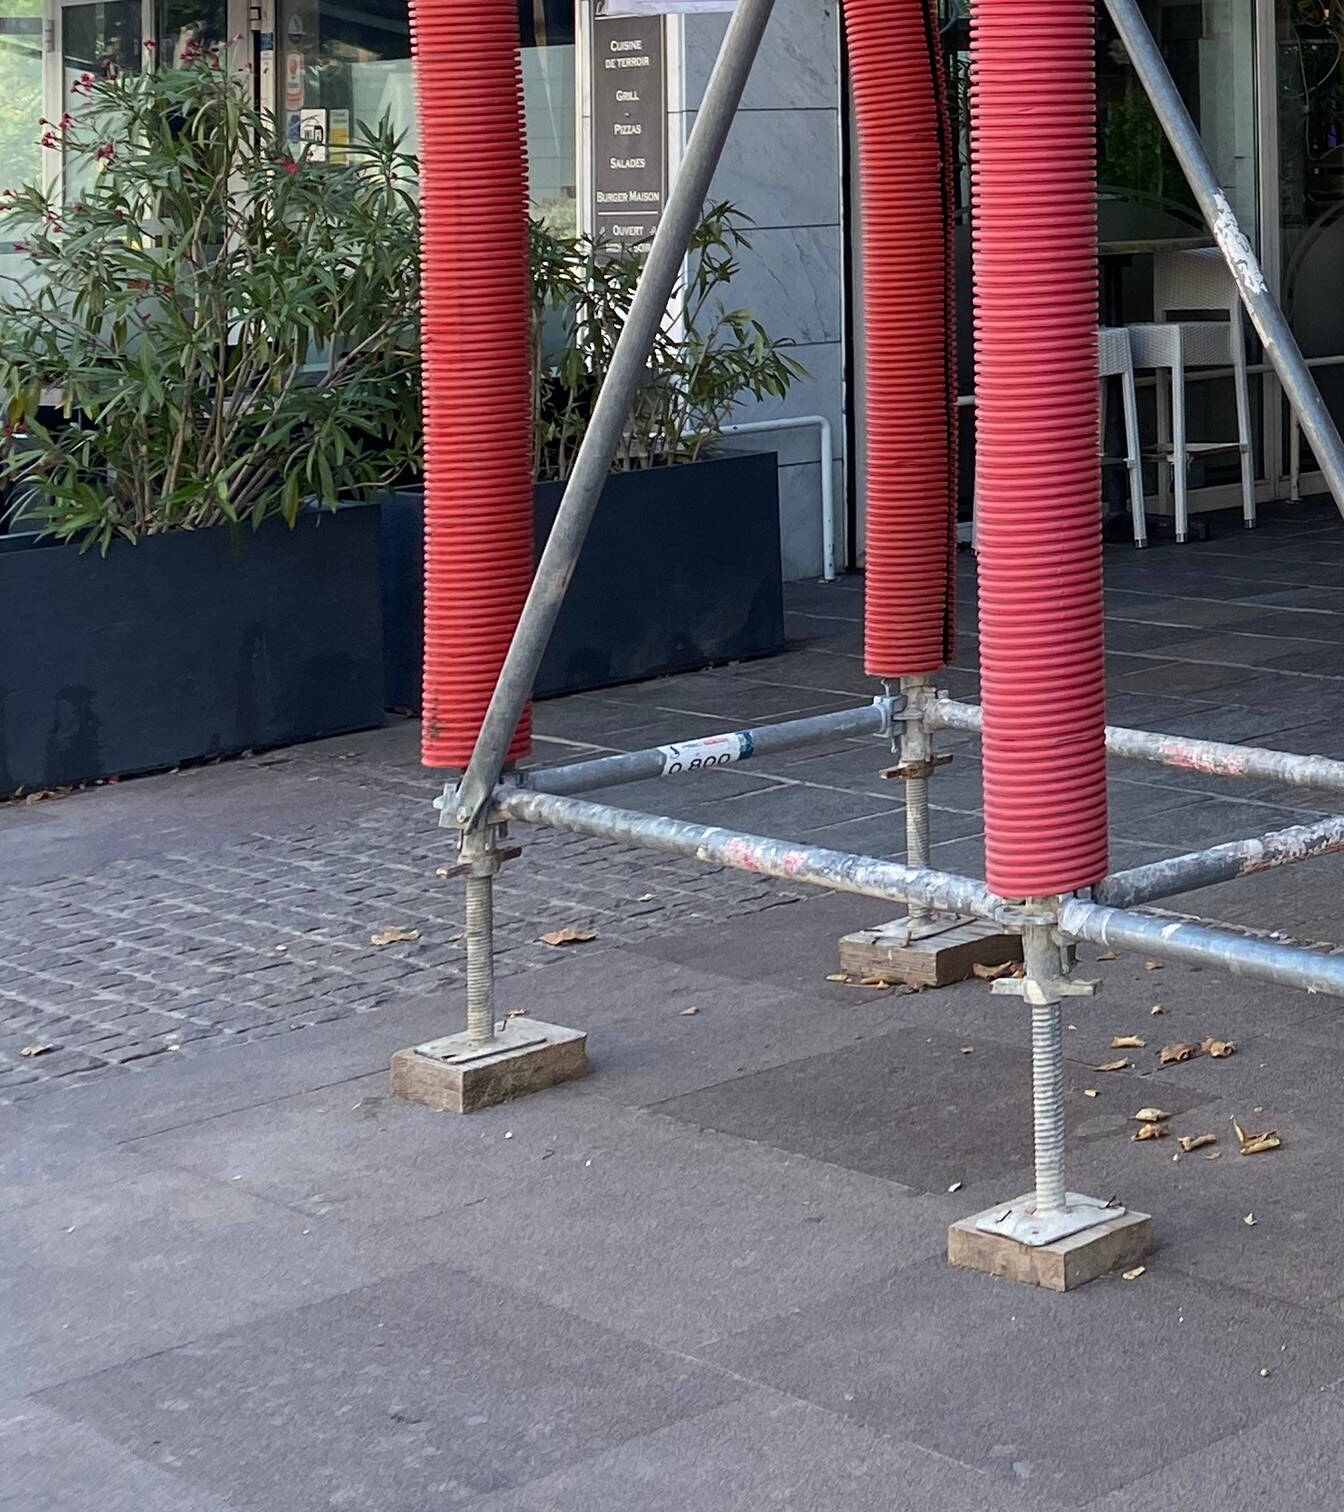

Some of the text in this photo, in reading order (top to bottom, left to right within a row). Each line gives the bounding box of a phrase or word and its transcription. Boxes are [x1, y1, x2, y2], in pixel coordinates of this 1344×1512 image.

[614, 124, 642, 135] PIZZAS
[610, 157, 646, 169] SALADES
[597, 190, 660, 202] BURGER MAISON
[612, 224, 644, 236] OUVERT
